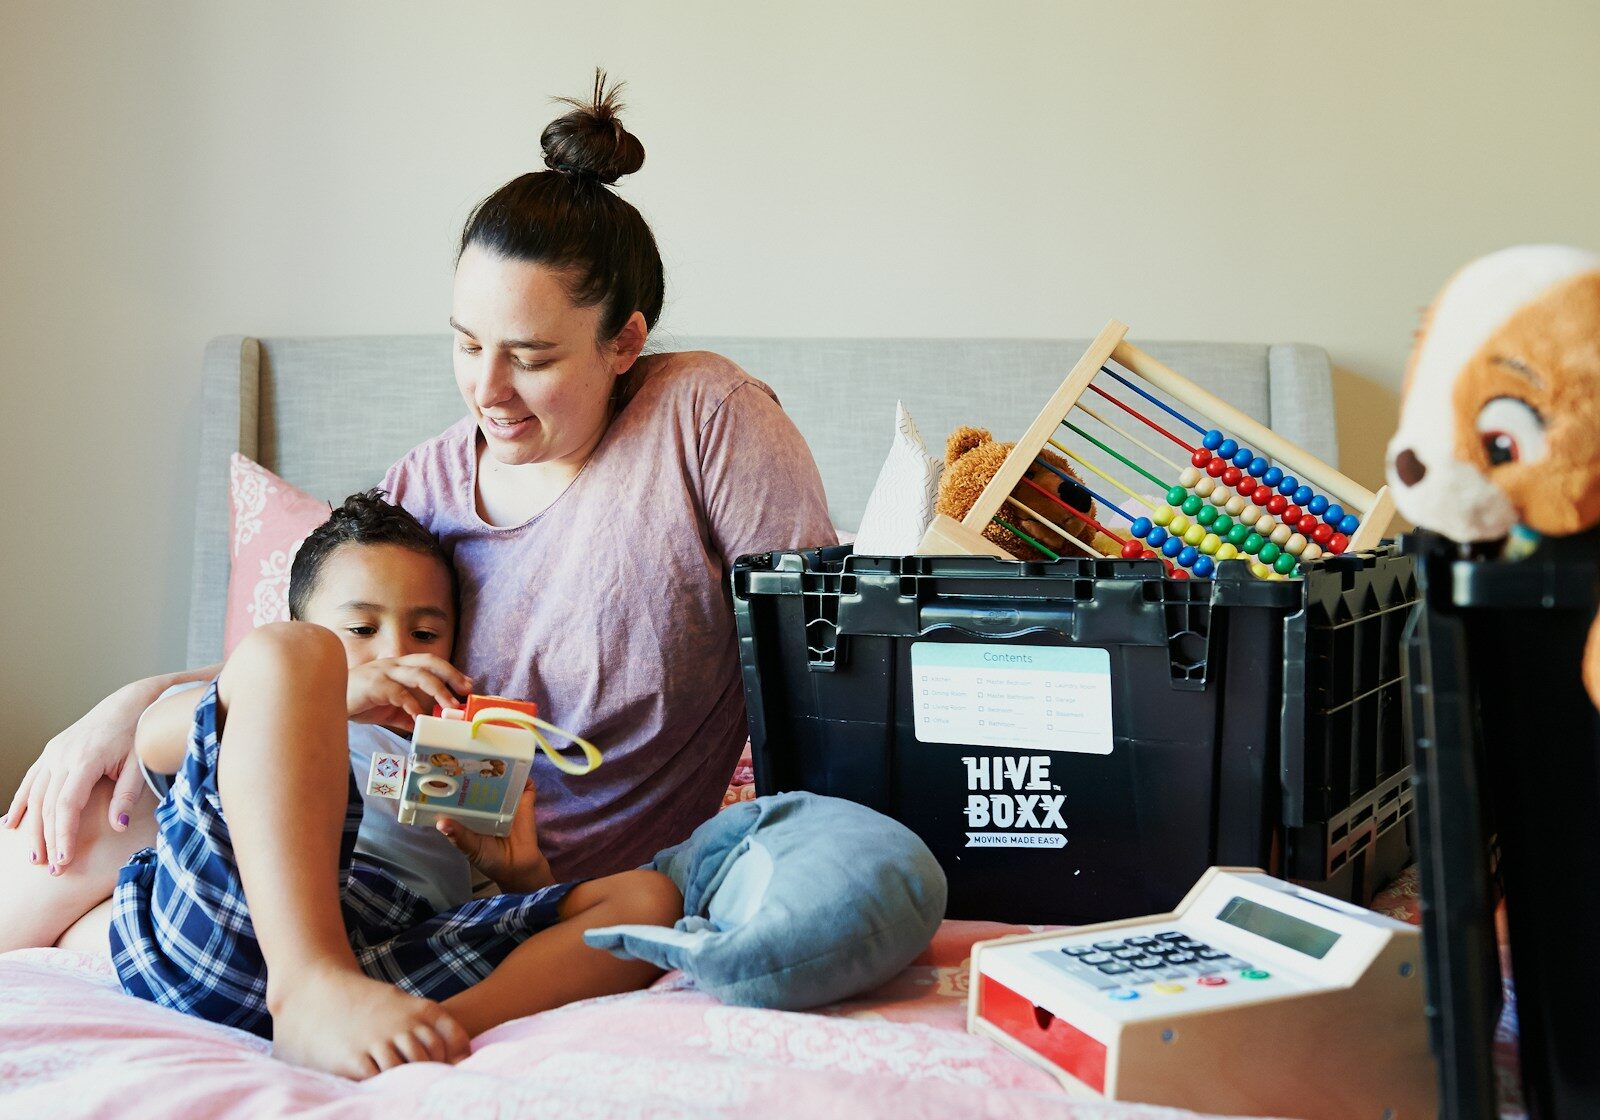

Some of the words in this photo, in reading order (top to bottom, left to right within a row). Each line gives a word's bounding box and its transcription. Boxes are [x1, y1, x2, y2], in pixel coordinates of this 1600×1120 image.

[983, 652, 1033, 663] Contents
[961, 756, 1051, 791] HIVE
[963, 794, 1068, 829] BOXX
[974, 836, 1008, 844] MOVING
[1010, 836, 1036, 844] MADE
[1037, 836, 1060, 845] EASY
